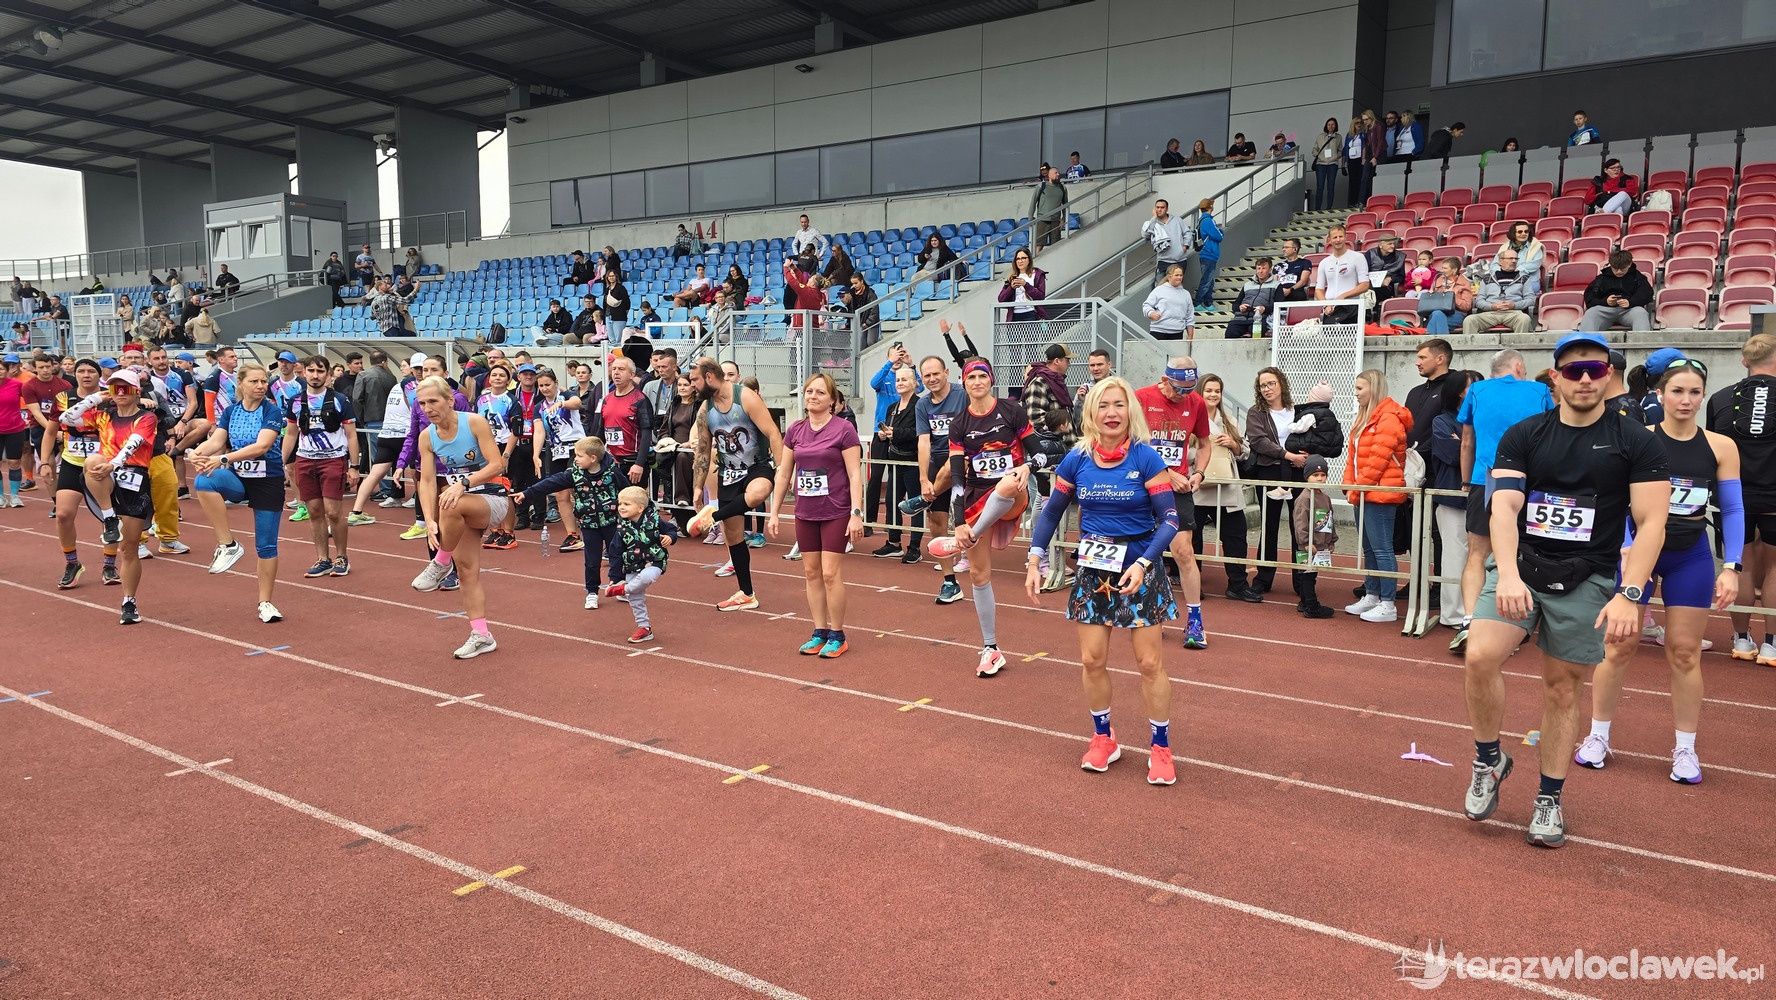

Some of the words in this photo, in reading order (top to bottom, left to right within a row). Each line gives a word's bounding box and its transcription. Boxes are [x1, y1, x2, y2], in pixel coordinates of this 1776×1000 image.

[694, 221, 717, 239] A4
[1750, 387, 1768, 434] OUTDOOR
[1152, 430, 1168, 440] RUN
[1170, 430, 1187, 440] THIS
[72, 442, 95, 451] 428
[1157, 447, 1179, 458] 534
[237, 461, 260, 471] 207
[979, 458, 1007, 471] 288
[800, 477, 822, 489] 355
[1535, 506, 1583, 527] 555
[1084, 541, 1118, 560] 722
